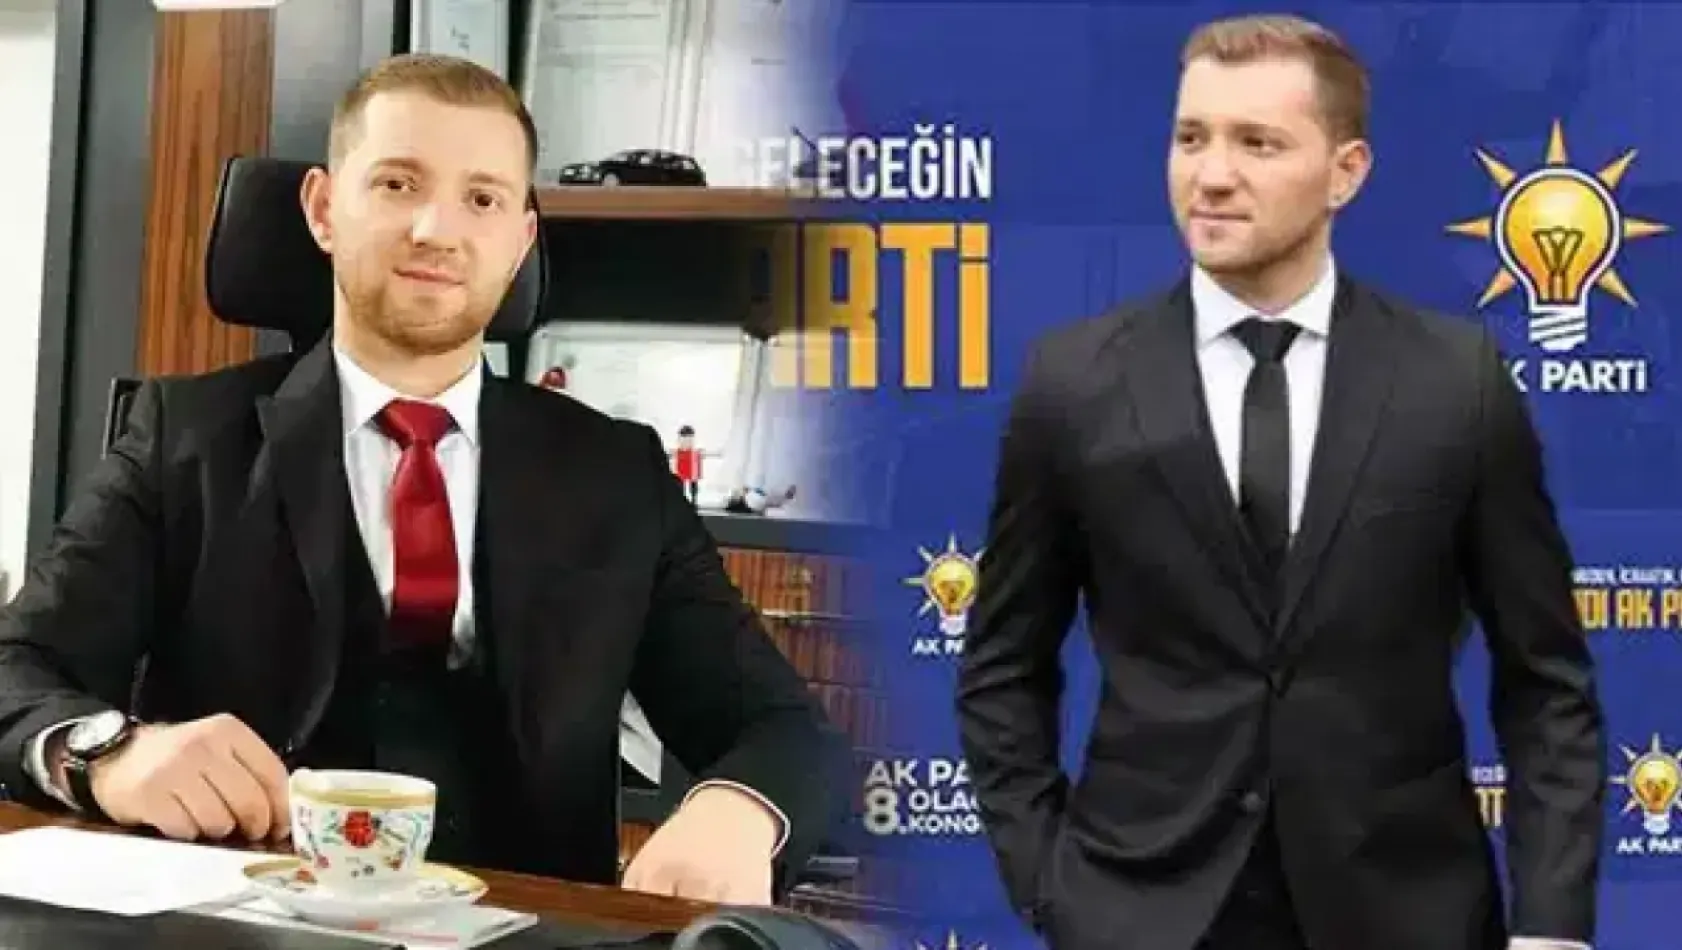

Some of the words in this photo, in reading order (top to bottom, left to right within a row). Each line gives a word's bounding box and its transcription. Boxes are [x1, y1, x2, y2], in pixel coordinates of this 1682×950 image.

[1616, 587, 1654, 630] AK
[911, 638, 941, 655] AK
[865, 760, 918, 787] AK
[1616, 837, 1645, 855] AK
